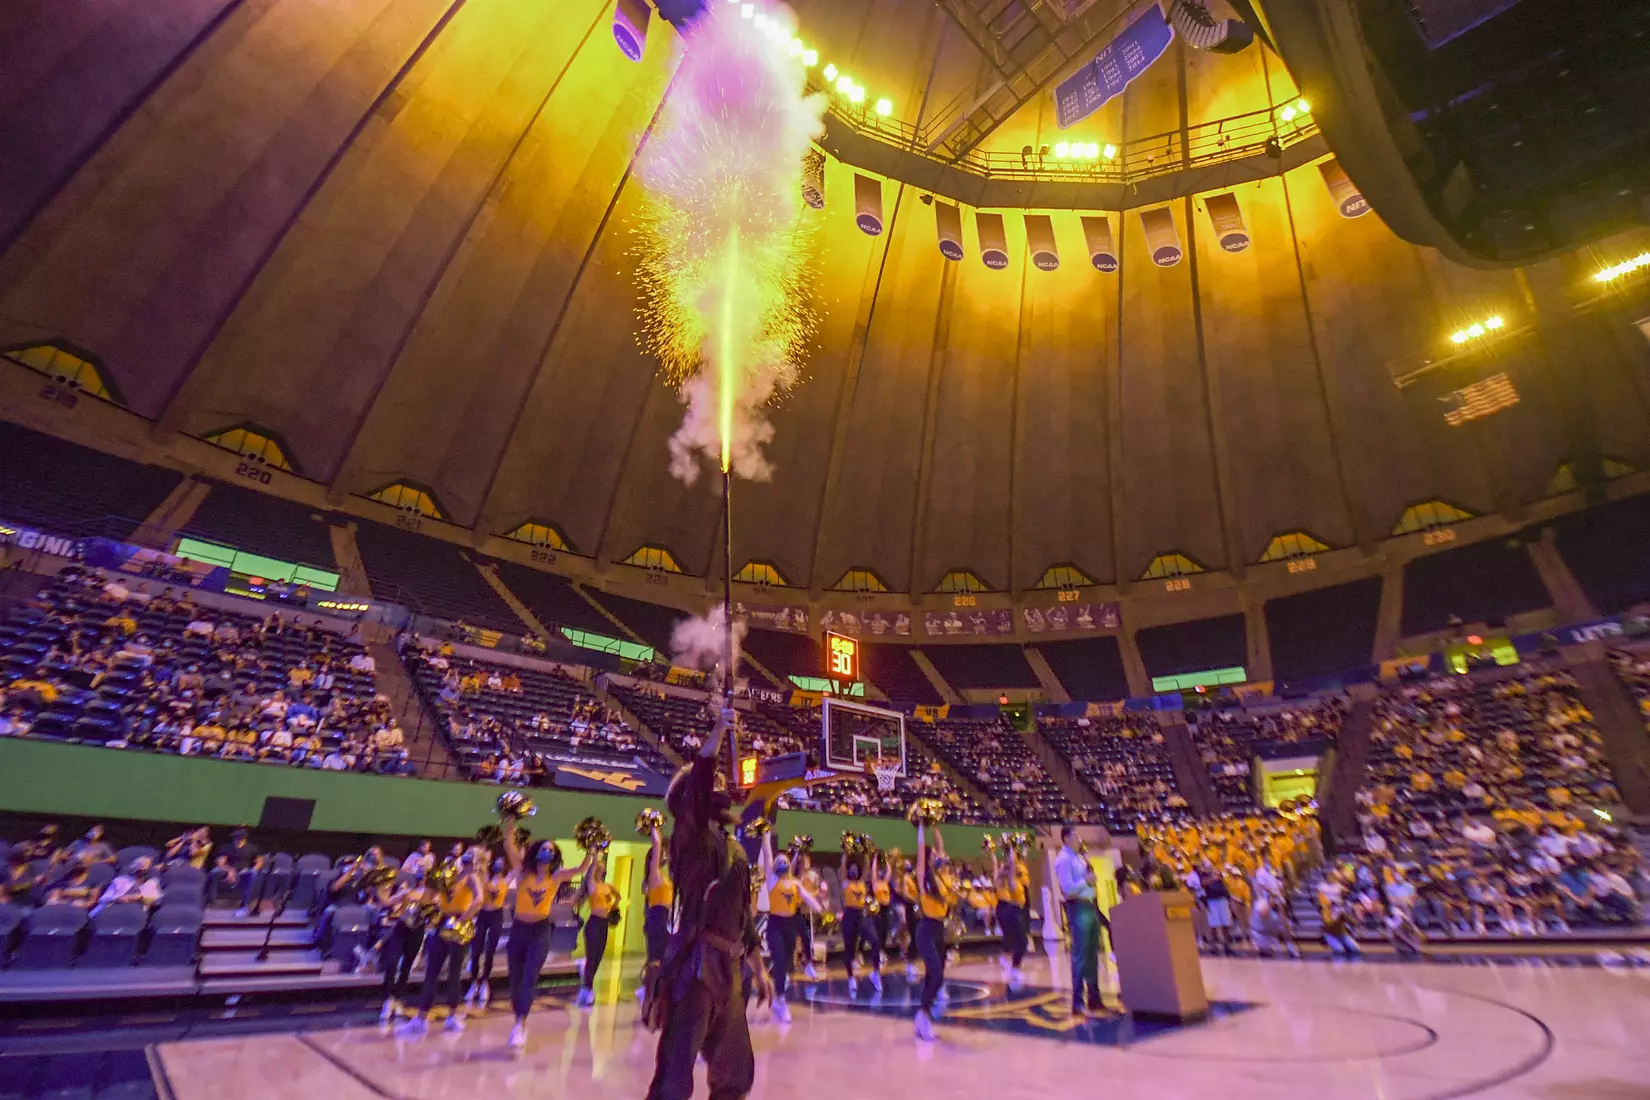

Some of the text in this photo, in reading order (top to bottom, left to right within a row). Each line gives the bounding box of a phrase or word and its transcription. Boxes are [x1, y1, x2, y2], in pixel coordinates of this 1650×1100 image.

[616, 34, 640, 61] NCAA
[1095, 44, 1113, 64] NIT
[1346, 199, 1367, 214] NIT
[860, 223, 881, 234] NCAA
[1225, 240, 1249, 250] NCAA
[943, 249, 962, 259] NCAA
[1157, 254, 1181, 264] NCAA
[235, 462, 272, 485] 220
[1058, 590, 1080, 602] 227
[832, 651, 851, 675] 30
